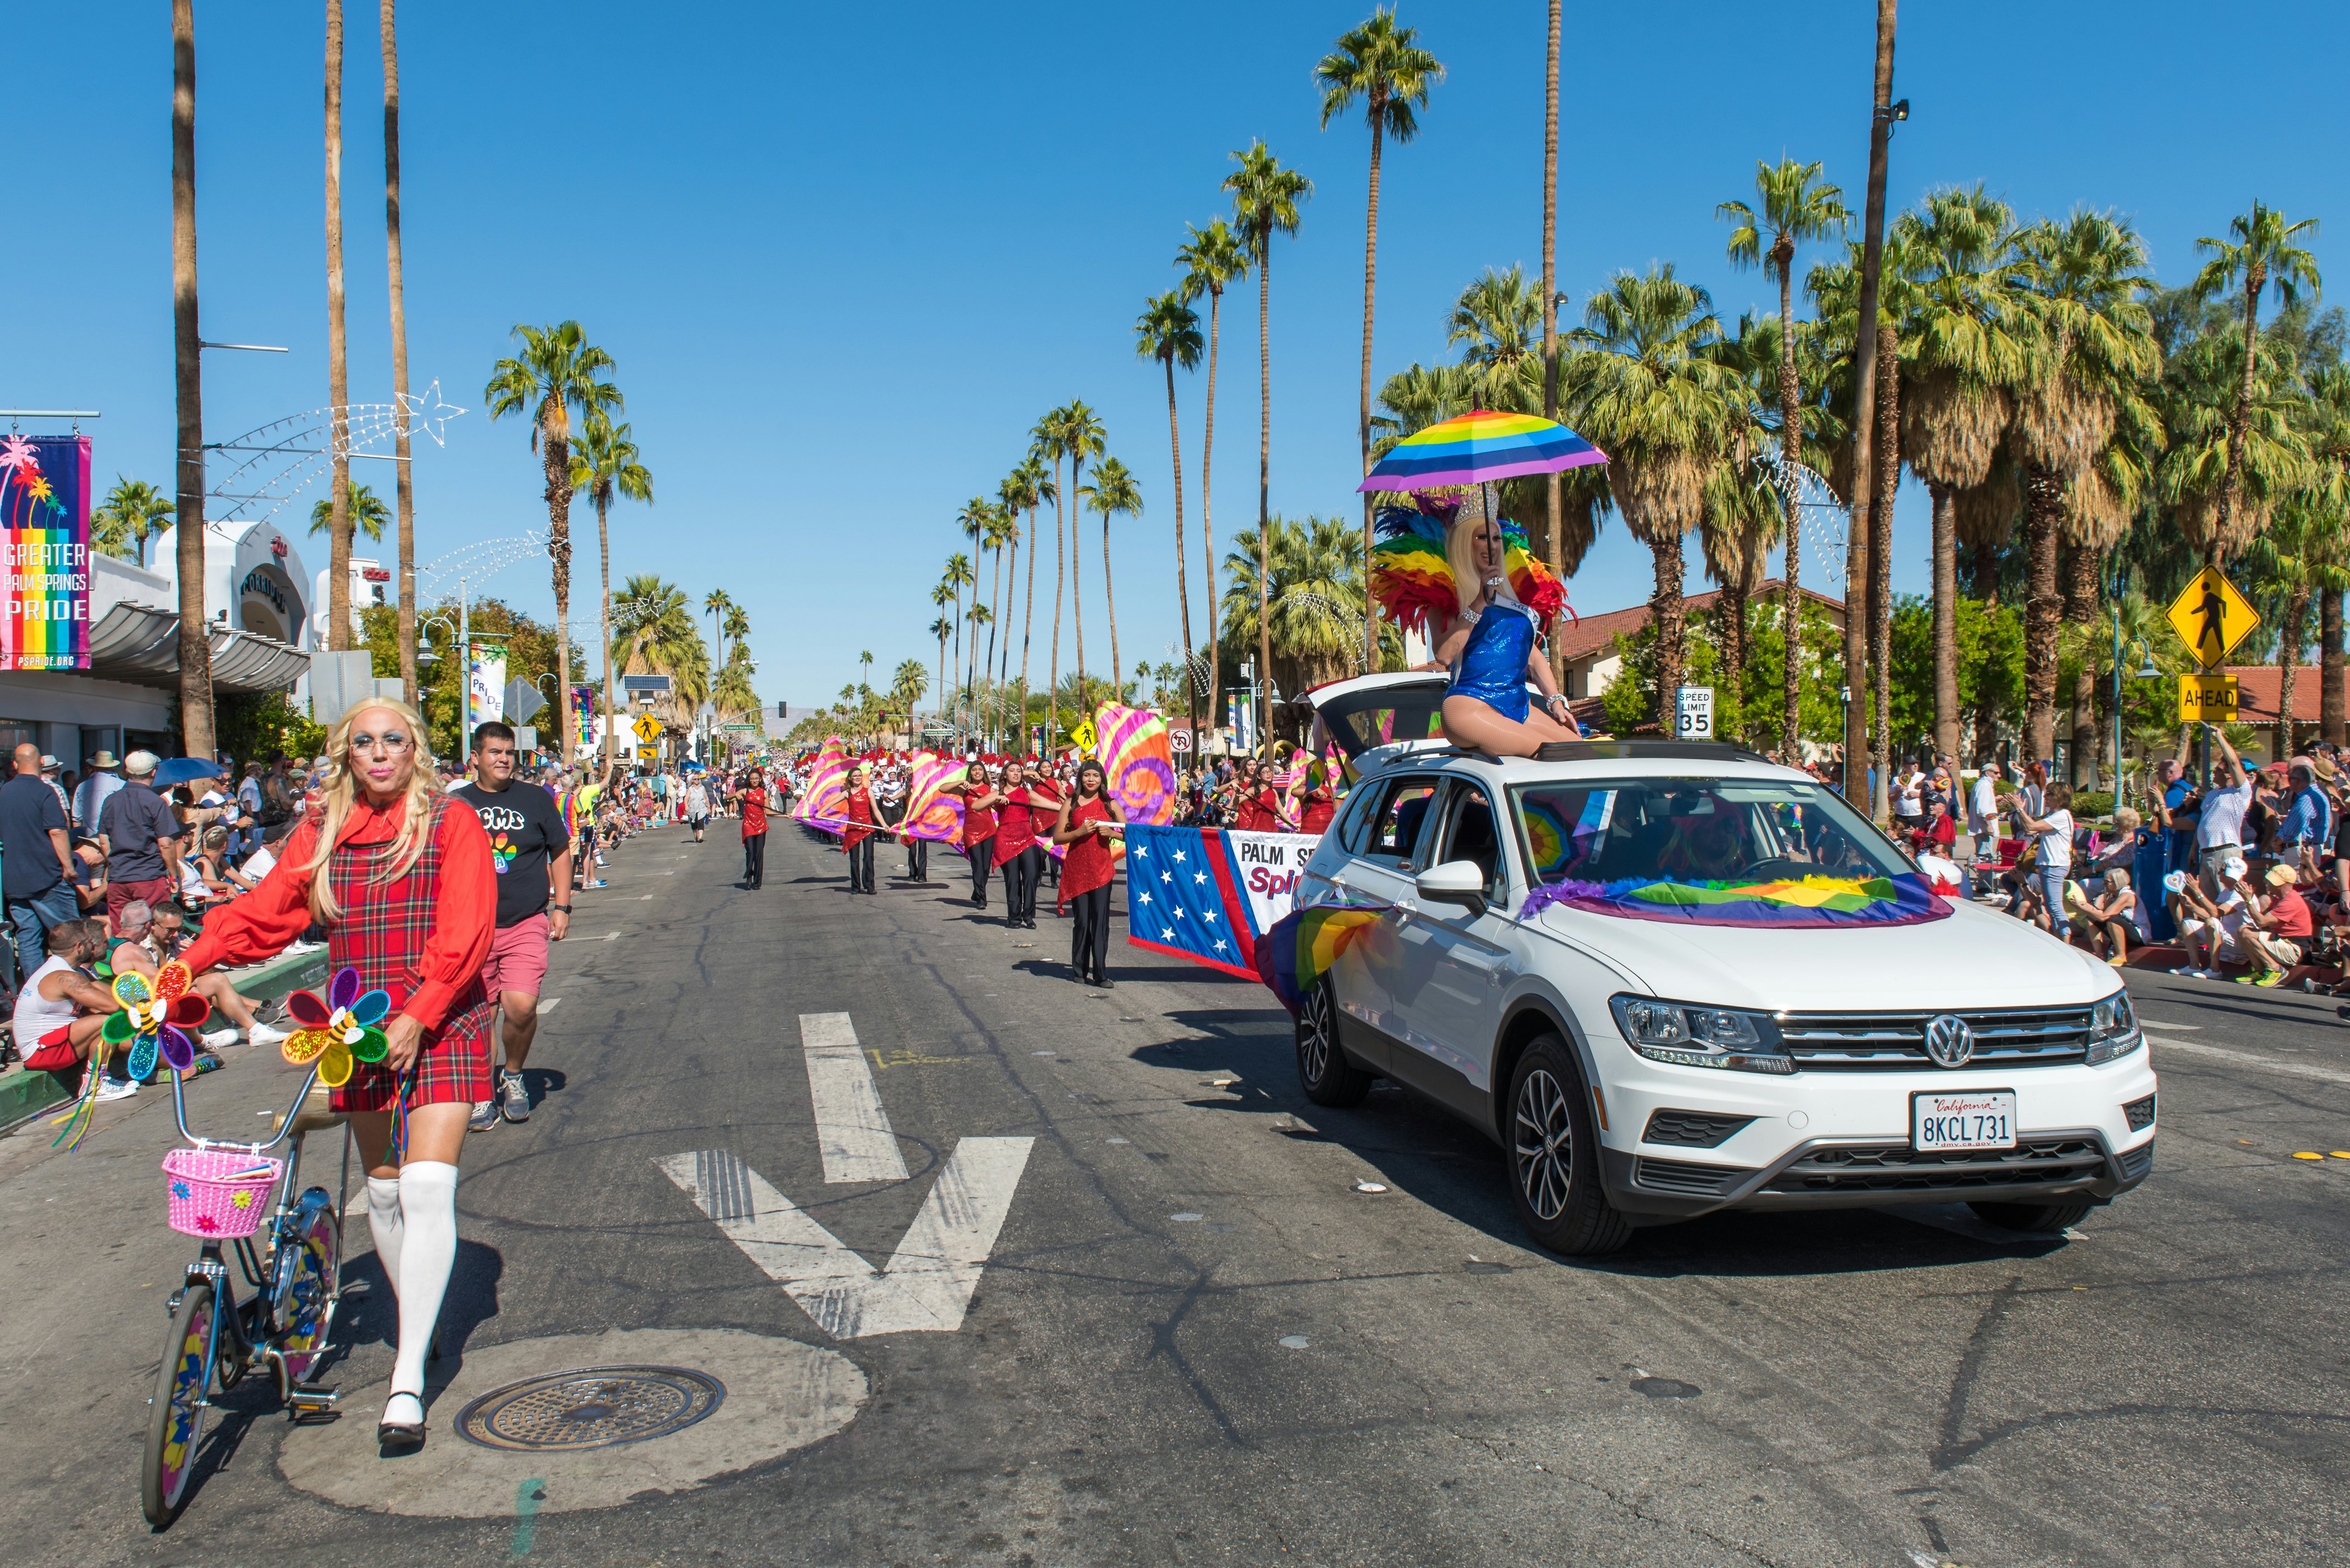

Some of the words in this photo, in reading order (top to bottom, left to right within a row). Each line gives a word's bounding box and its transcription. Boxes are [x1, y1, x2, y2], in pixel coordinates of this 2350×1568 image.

[4, 543, 86, 566] GREATER
[4, 574, 34, 591] PALM
[37, 573, 86, 591] SPRINGS
[364, 568, 390, 581] the
[4, 600, 87, 621] PRIDE
[1511, 602, 1531, 614] Miss
[18, 656, 74, 667] PSPRIDE.ORG
[473, 679, 501, 711] PRIDE
[2184, 690, 2234, 707] AHEAD
[1230, 716, 1249, 734] PRIDE
[1679, 714, 1708, 732] 35
[1242, 843, 1284, 865] PALM
[1937, 1099, 1997, 1115] California
[1923, 1115, 2009, 1142] 8KCL731
